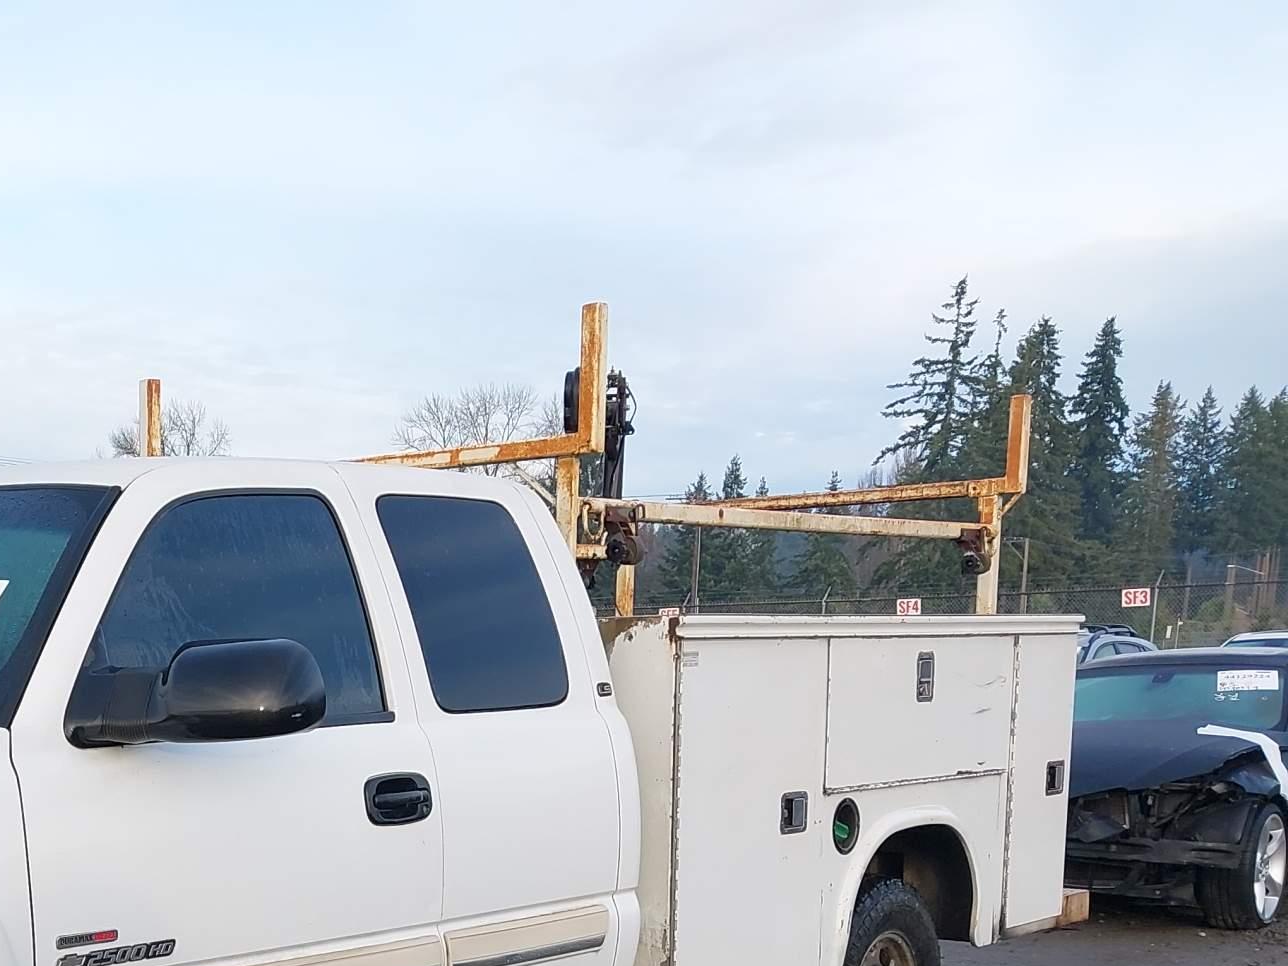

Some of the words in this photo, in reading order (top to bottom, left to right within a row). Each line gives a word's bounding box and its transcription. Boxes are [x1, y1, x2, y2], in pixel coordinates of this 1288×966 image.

[1124, 590, 1148, 605] SF3
[898, 600, 919, 613] SF4
[598, 685, 611, 695] LS
[148, 941, 174, 957] HD
